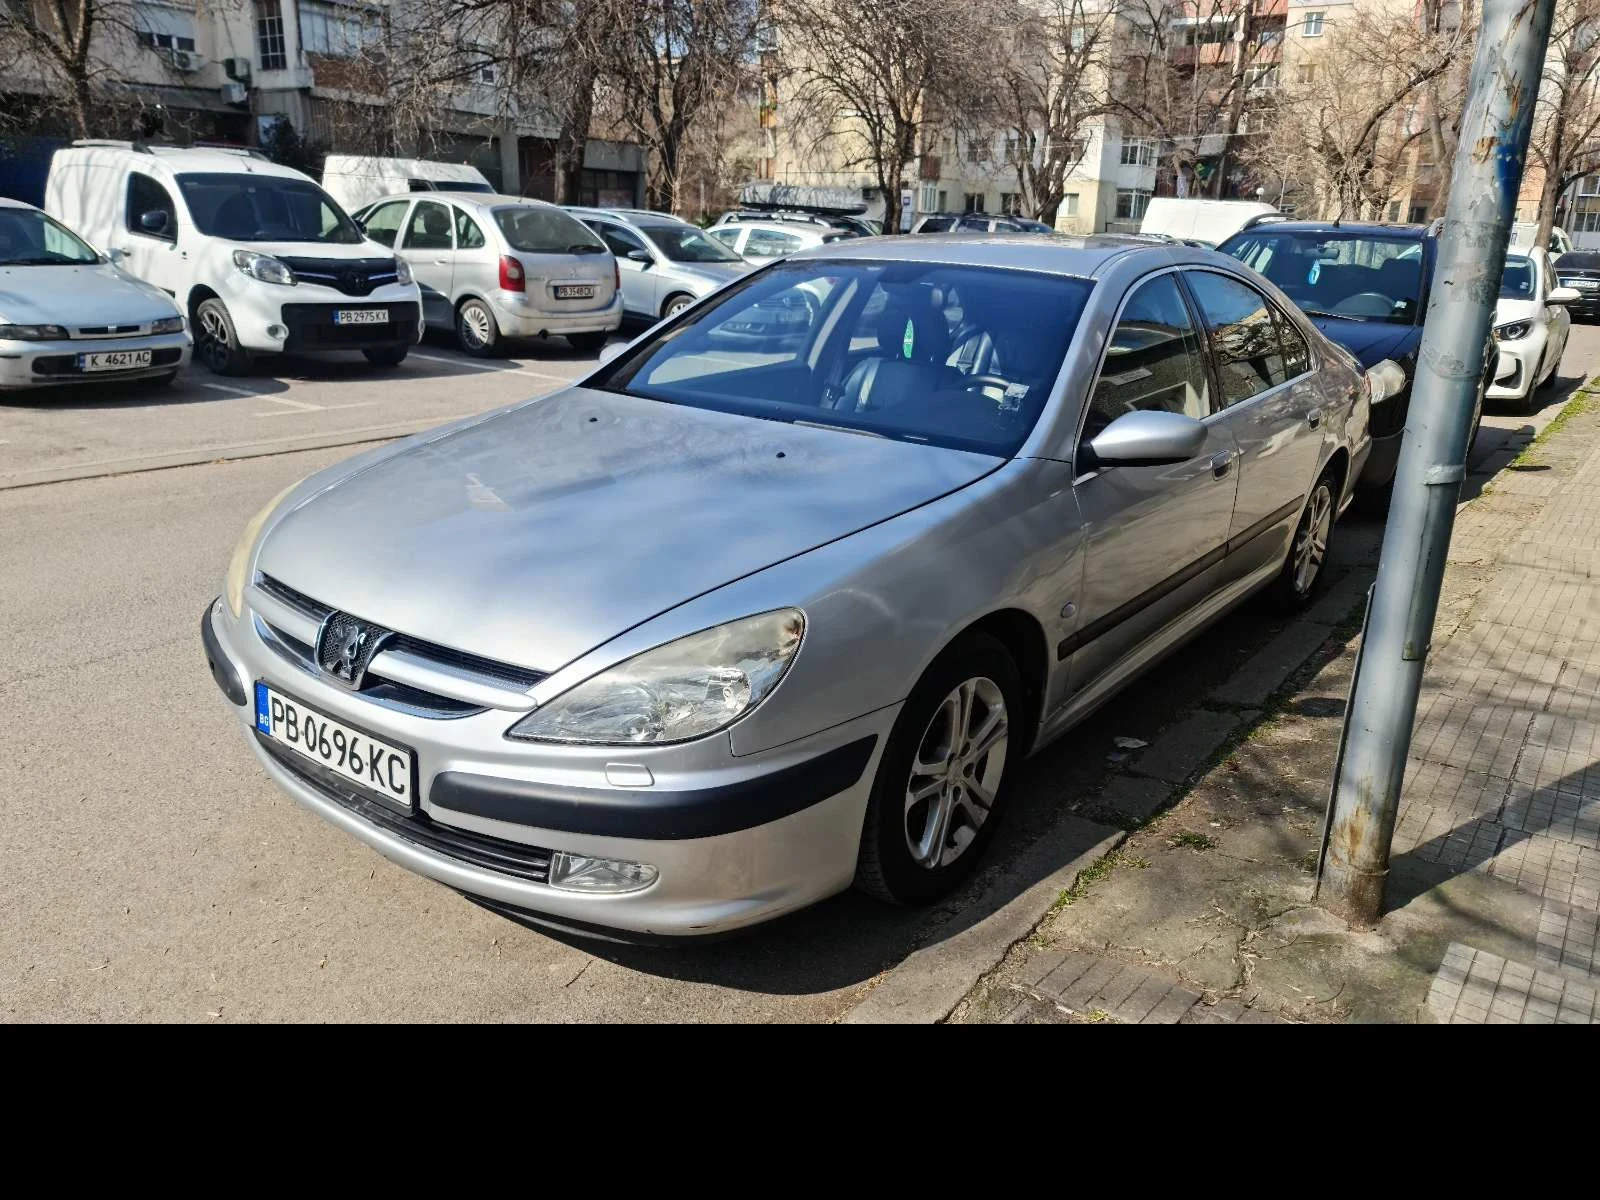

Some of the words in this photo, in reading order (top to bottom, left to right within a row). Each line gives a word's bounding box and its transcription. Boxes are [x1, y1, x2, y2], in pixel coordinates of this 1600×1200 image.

[340, 312, 353, 322] PB
[354, 311, 375, 322] 2975
[91, 355, 99, 367] K
[105, 353, 133, 365] 4621
[136, 351, 150, 363] AC
[259, 714, 269, 727] BG
[271, 696, 299, 744] PB
[304, 715, 364, 776] 0696
[369, 744, 406, 796] KC
